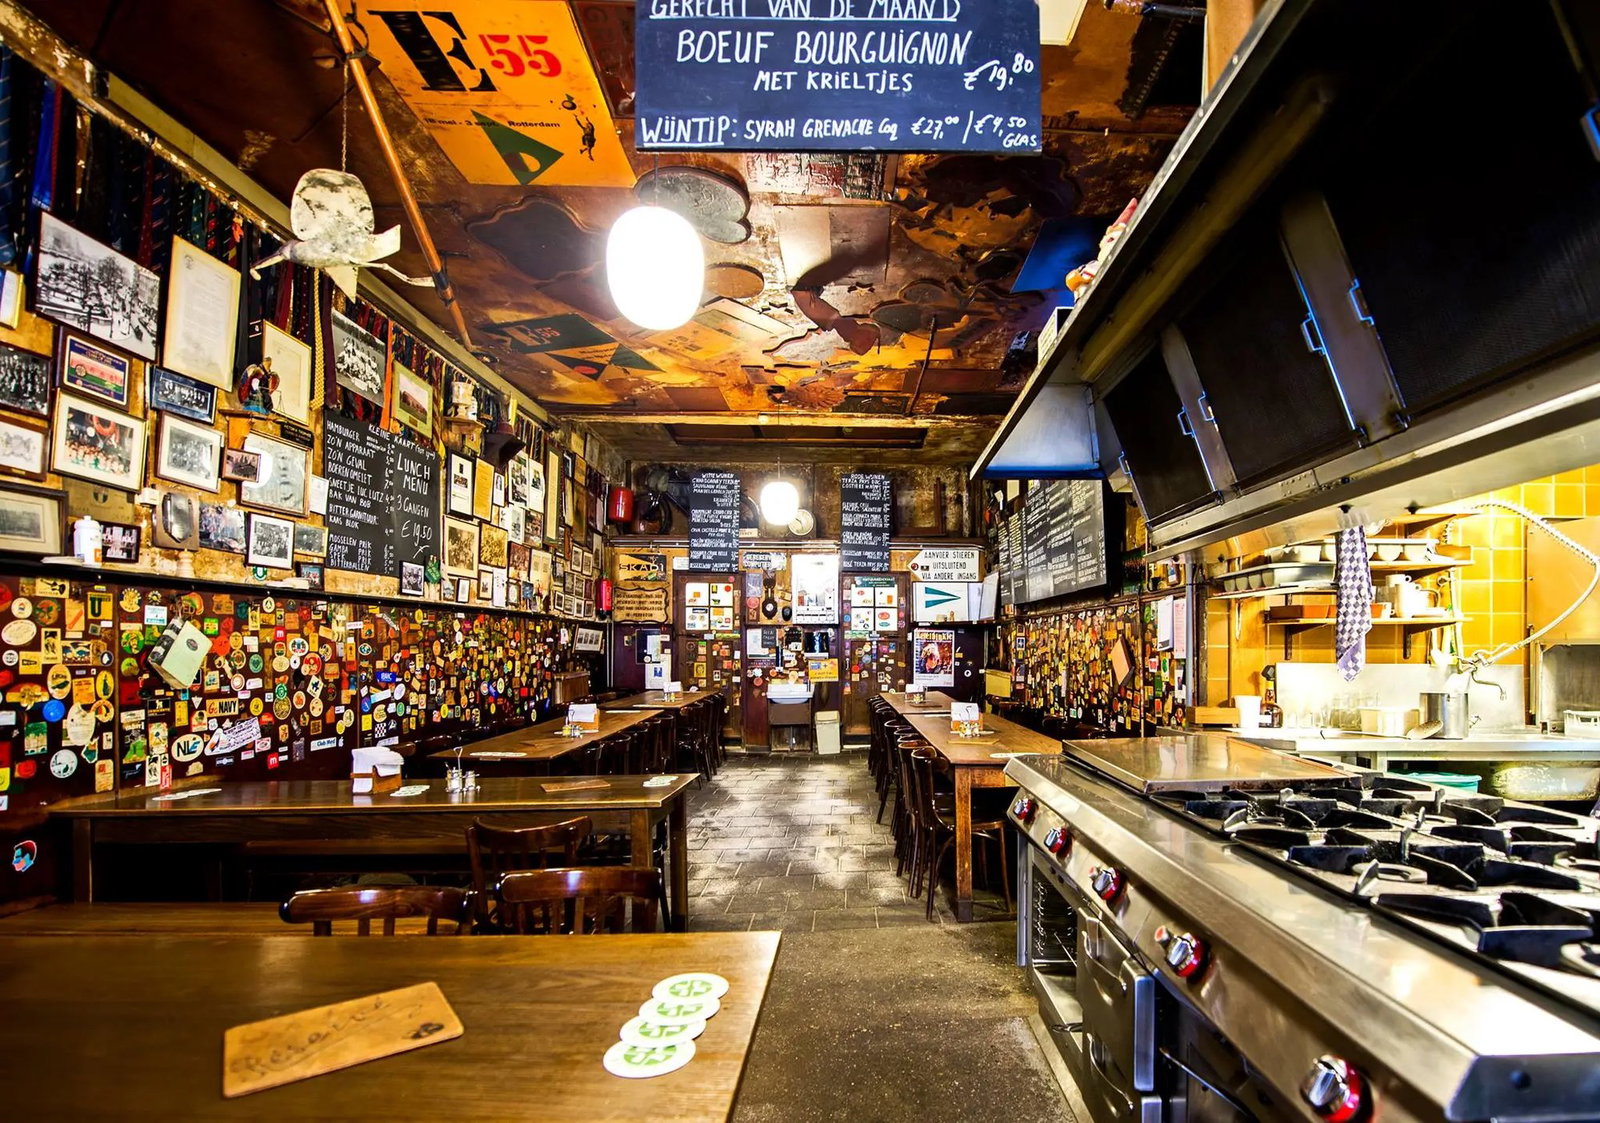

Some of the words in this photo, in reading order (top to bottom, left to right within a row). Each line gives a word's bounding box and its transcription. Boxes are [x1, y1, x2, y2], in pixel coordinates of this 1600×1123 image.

[768, 0, 812, 18] VAN
[868, 0, 961, 20] MAAND
[367, 10, 498, 92] E
[479, 34, 563, 77] 55
[676, 29, 773, 64] BOEUF
[753, 70, 797, 91] MET
[743, 118, 795, 143] SYRAH
[1002, 132, 1038, 148] GLAS
[327, 420, 360, 442] HAMBURGER
[369, 424, 391, 441] KLEINE
[394, 436, 416, 451] KAART
[345, 441, 376, 459] APPARAAT
[346, 455, 368, 471] GEVAL
[397, 452, 431, 480] LUNCH
[403, 474, 429, 495] MENU
[397, 494, 403, 511] 3
[403, 497, 429, 518] GANGEN
[329, 534, 357, 546] MOSSELEN
[619, 562, 666, 571] SKADI
[932, 561, 967, 570] UITSLUITEND
[921, 572, 932, 580] VIA
[934, 572, 954, 580] ANDERE
[957, 572, 977, 580] INGANG
[219, 700, 238, 714] NAVY
